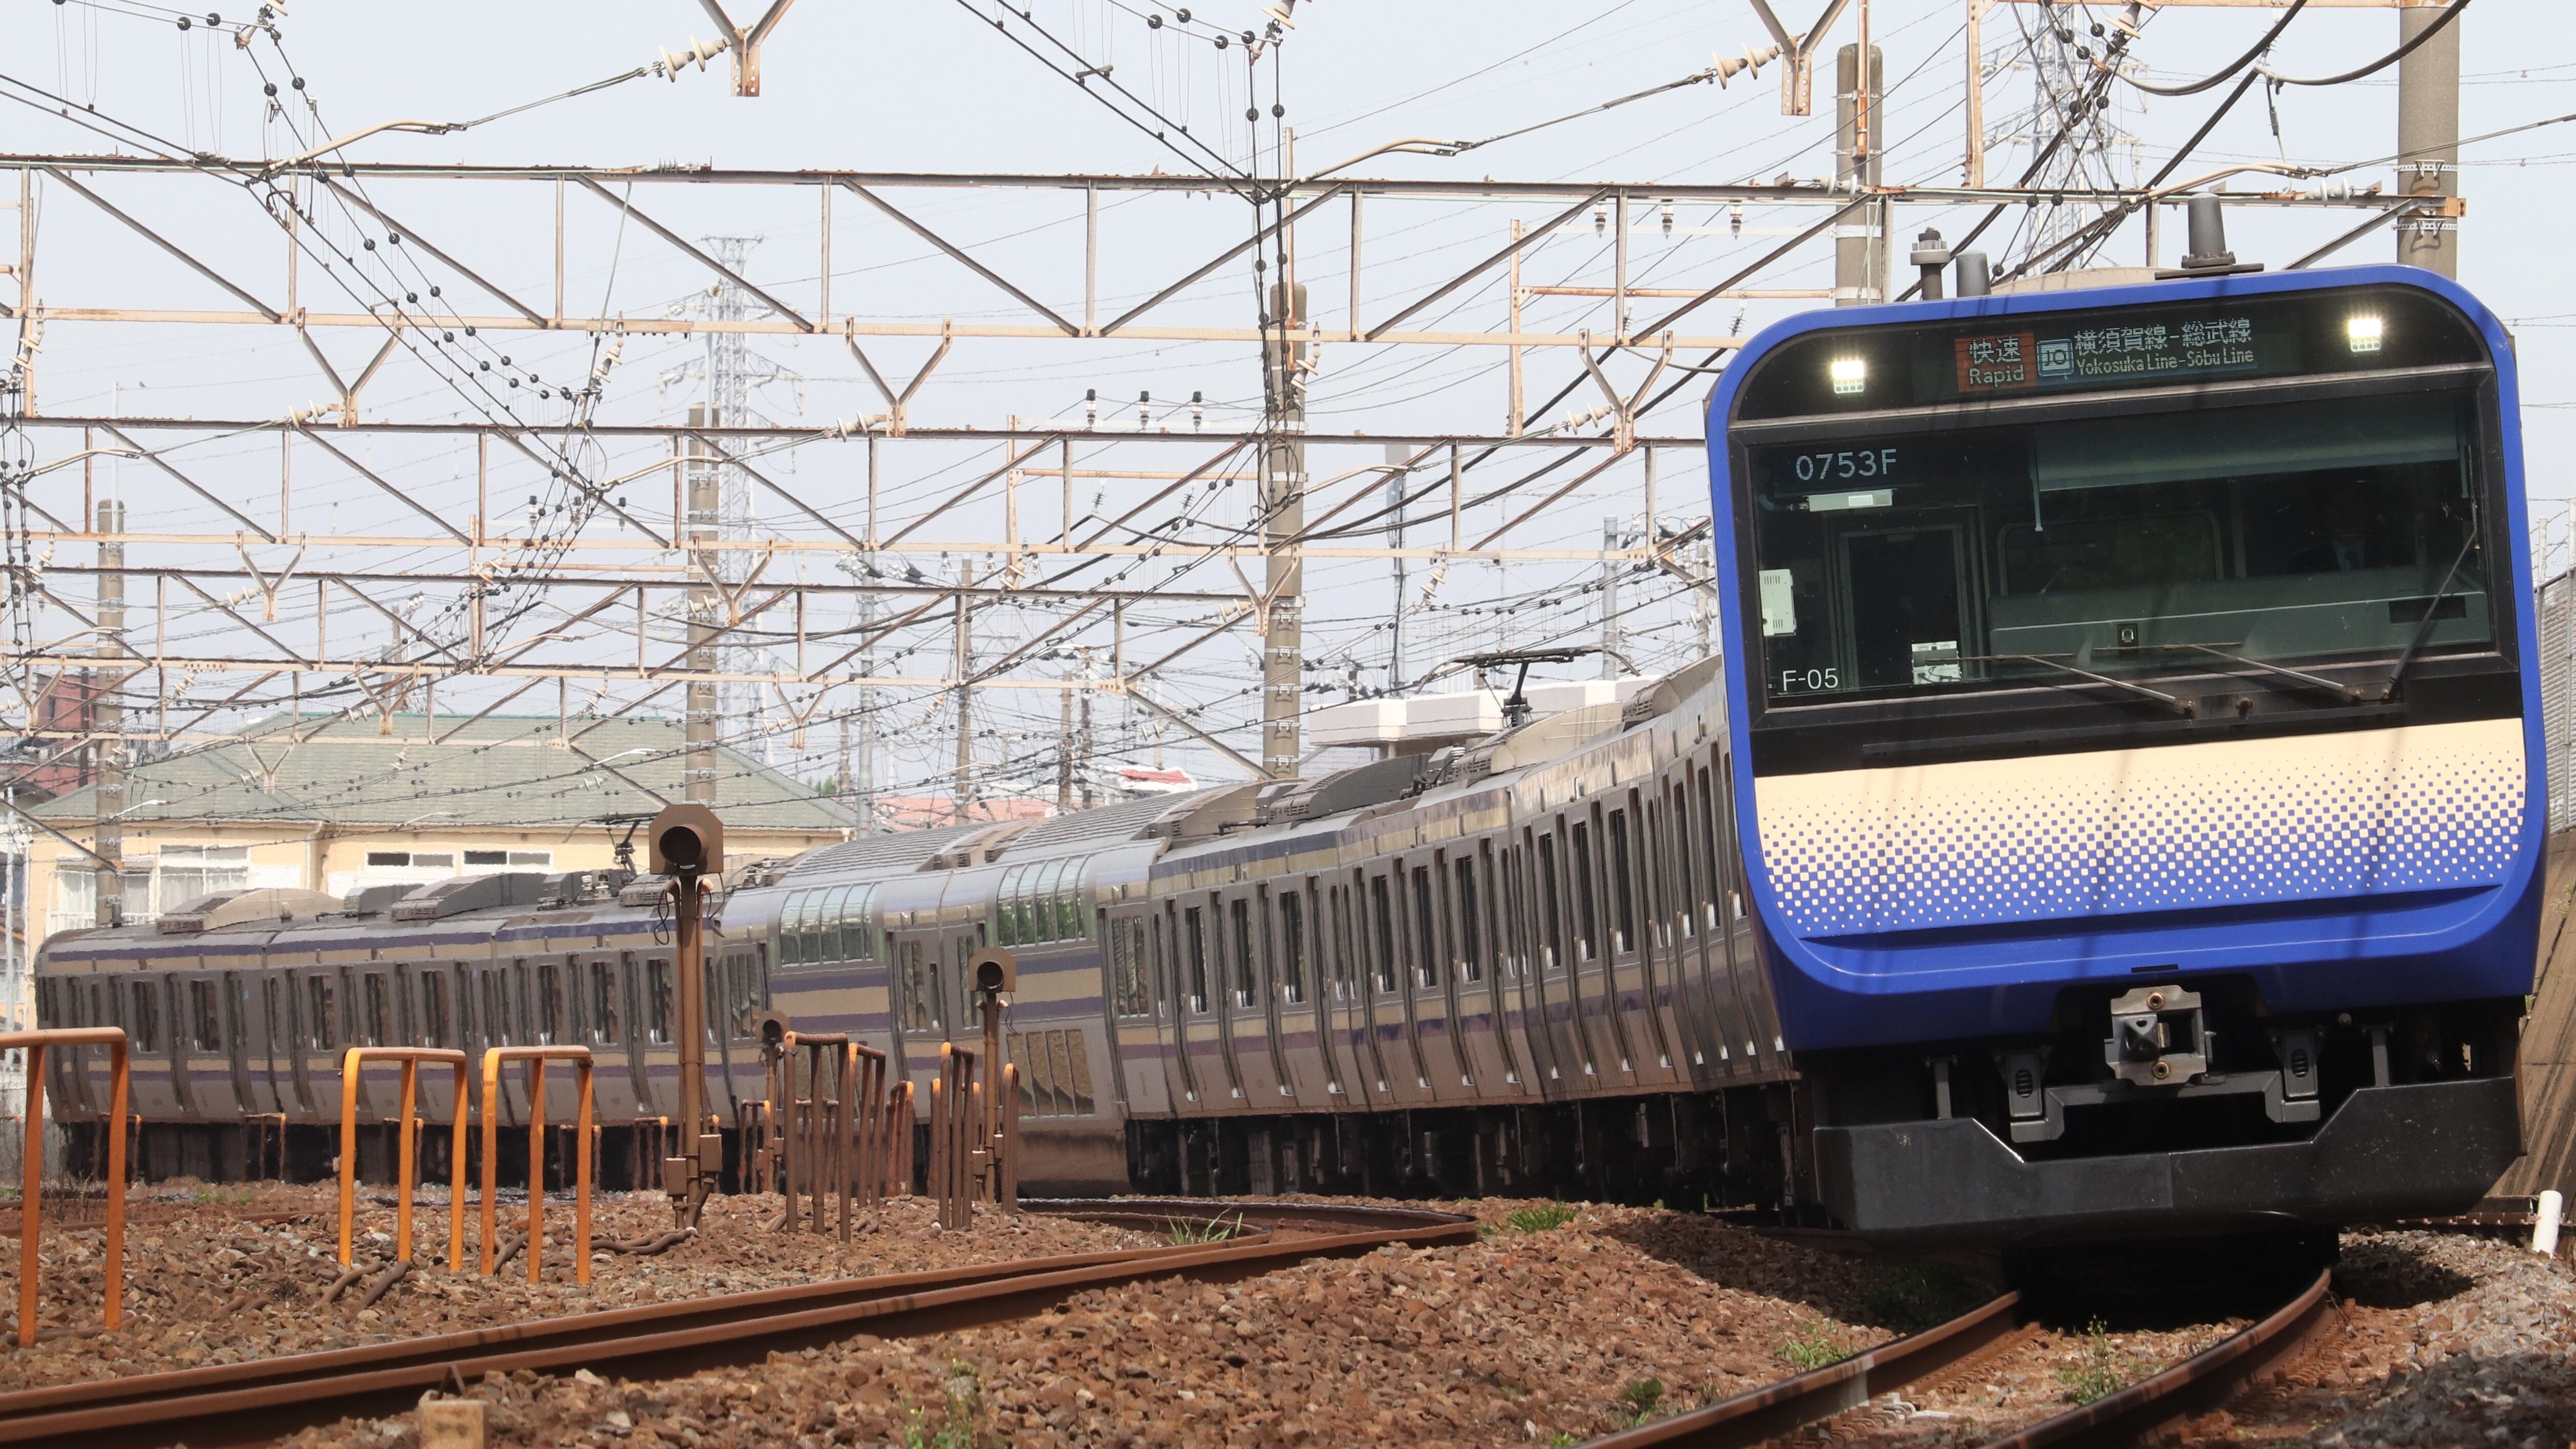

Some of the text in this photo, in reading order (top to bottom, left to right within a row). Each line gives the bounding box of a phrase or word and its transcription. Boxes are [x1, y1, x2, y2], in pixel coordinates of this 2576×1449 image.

[1969, 336, 2021, 365] 快速
[2044, 349, 2067, 366] JO
[2076, 354, 2144, 376] Yokosuka
[2223, 346, 2254, 364] Line
[1969, 364, 2024, 387] Rapid
[1796, 448, 1896, 481] 0753F
[1783, 668, 1838, 691] F-05
